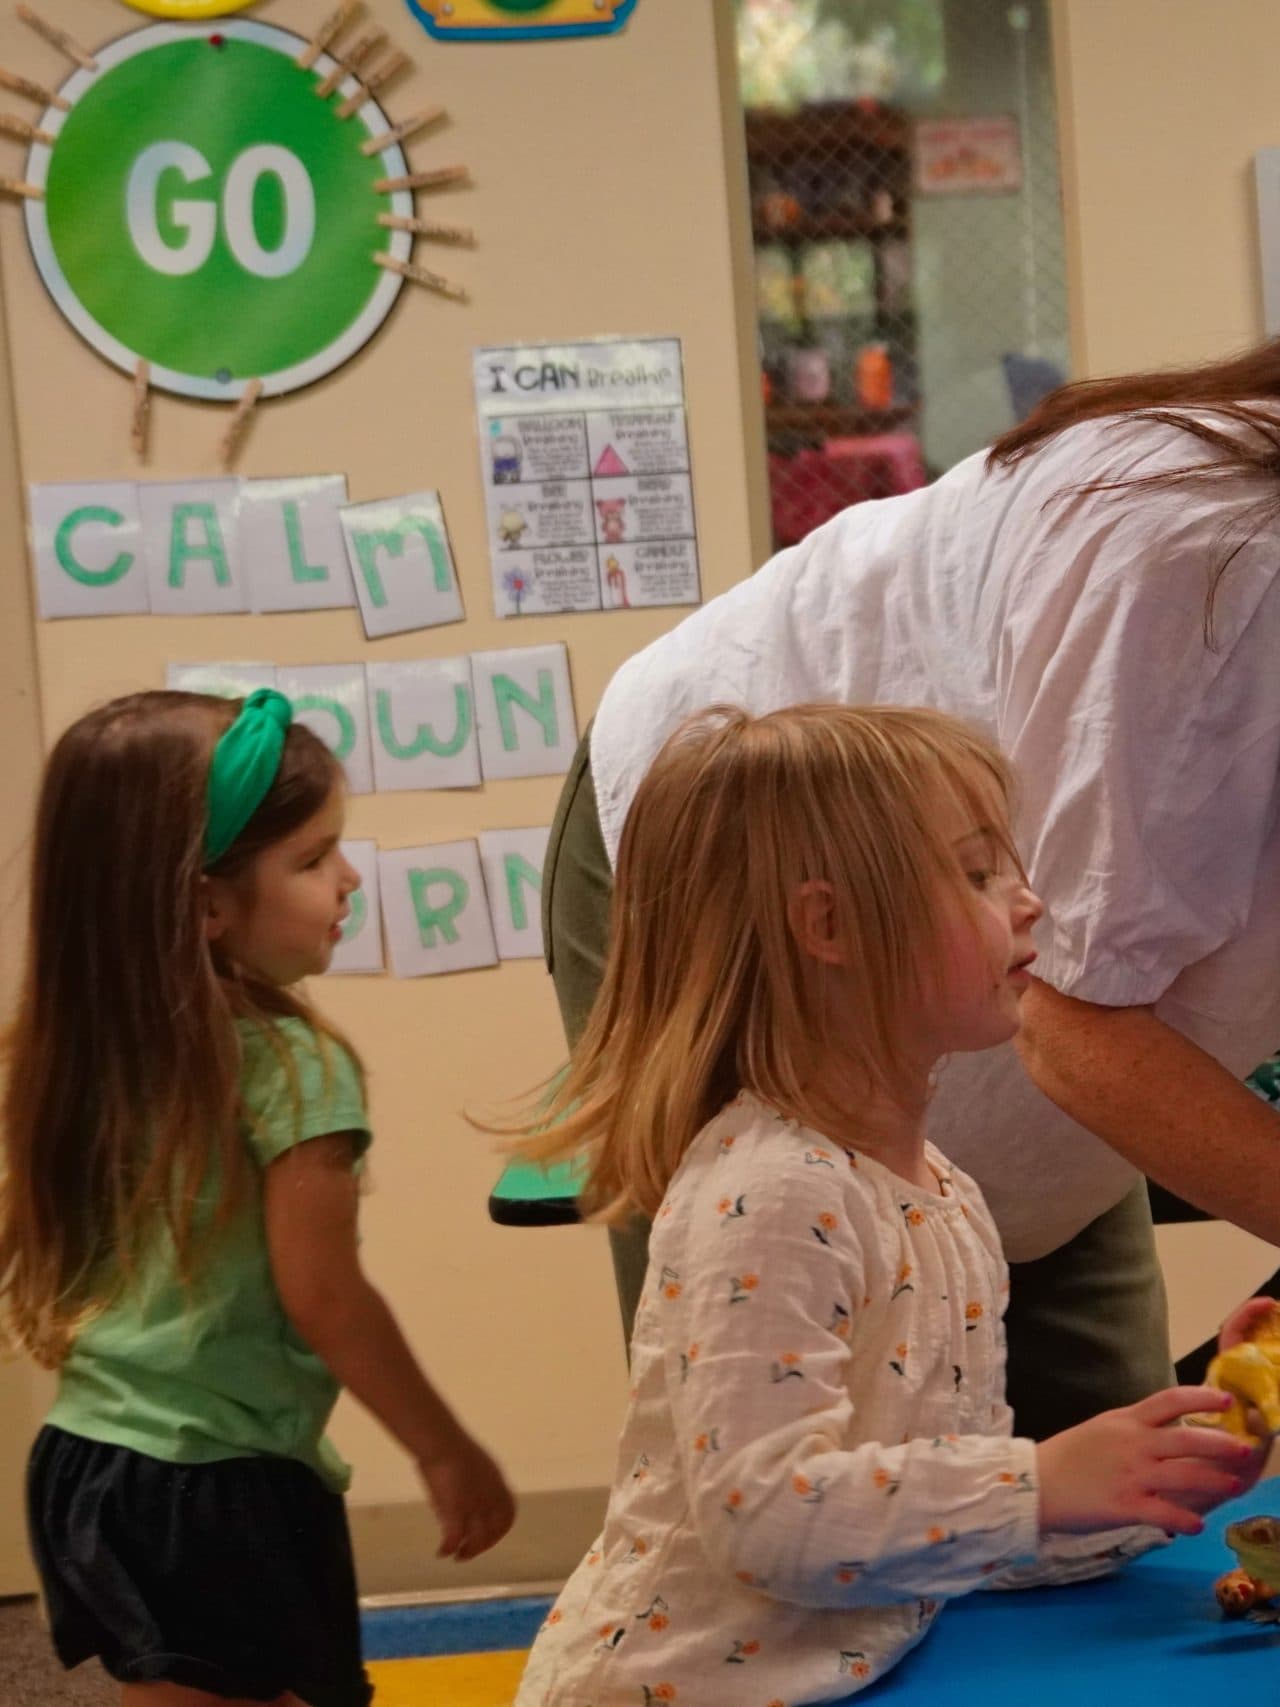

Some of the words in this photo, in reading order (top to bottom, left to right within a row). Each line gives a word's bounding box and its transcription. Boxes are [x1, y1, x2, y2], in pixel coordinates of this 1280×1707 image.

[125, 139, 317, 279] GO
[489, 365, 507, 393] I
[514, 361, 580, 391] CAN
[54, 503, 452, 608] CALM
